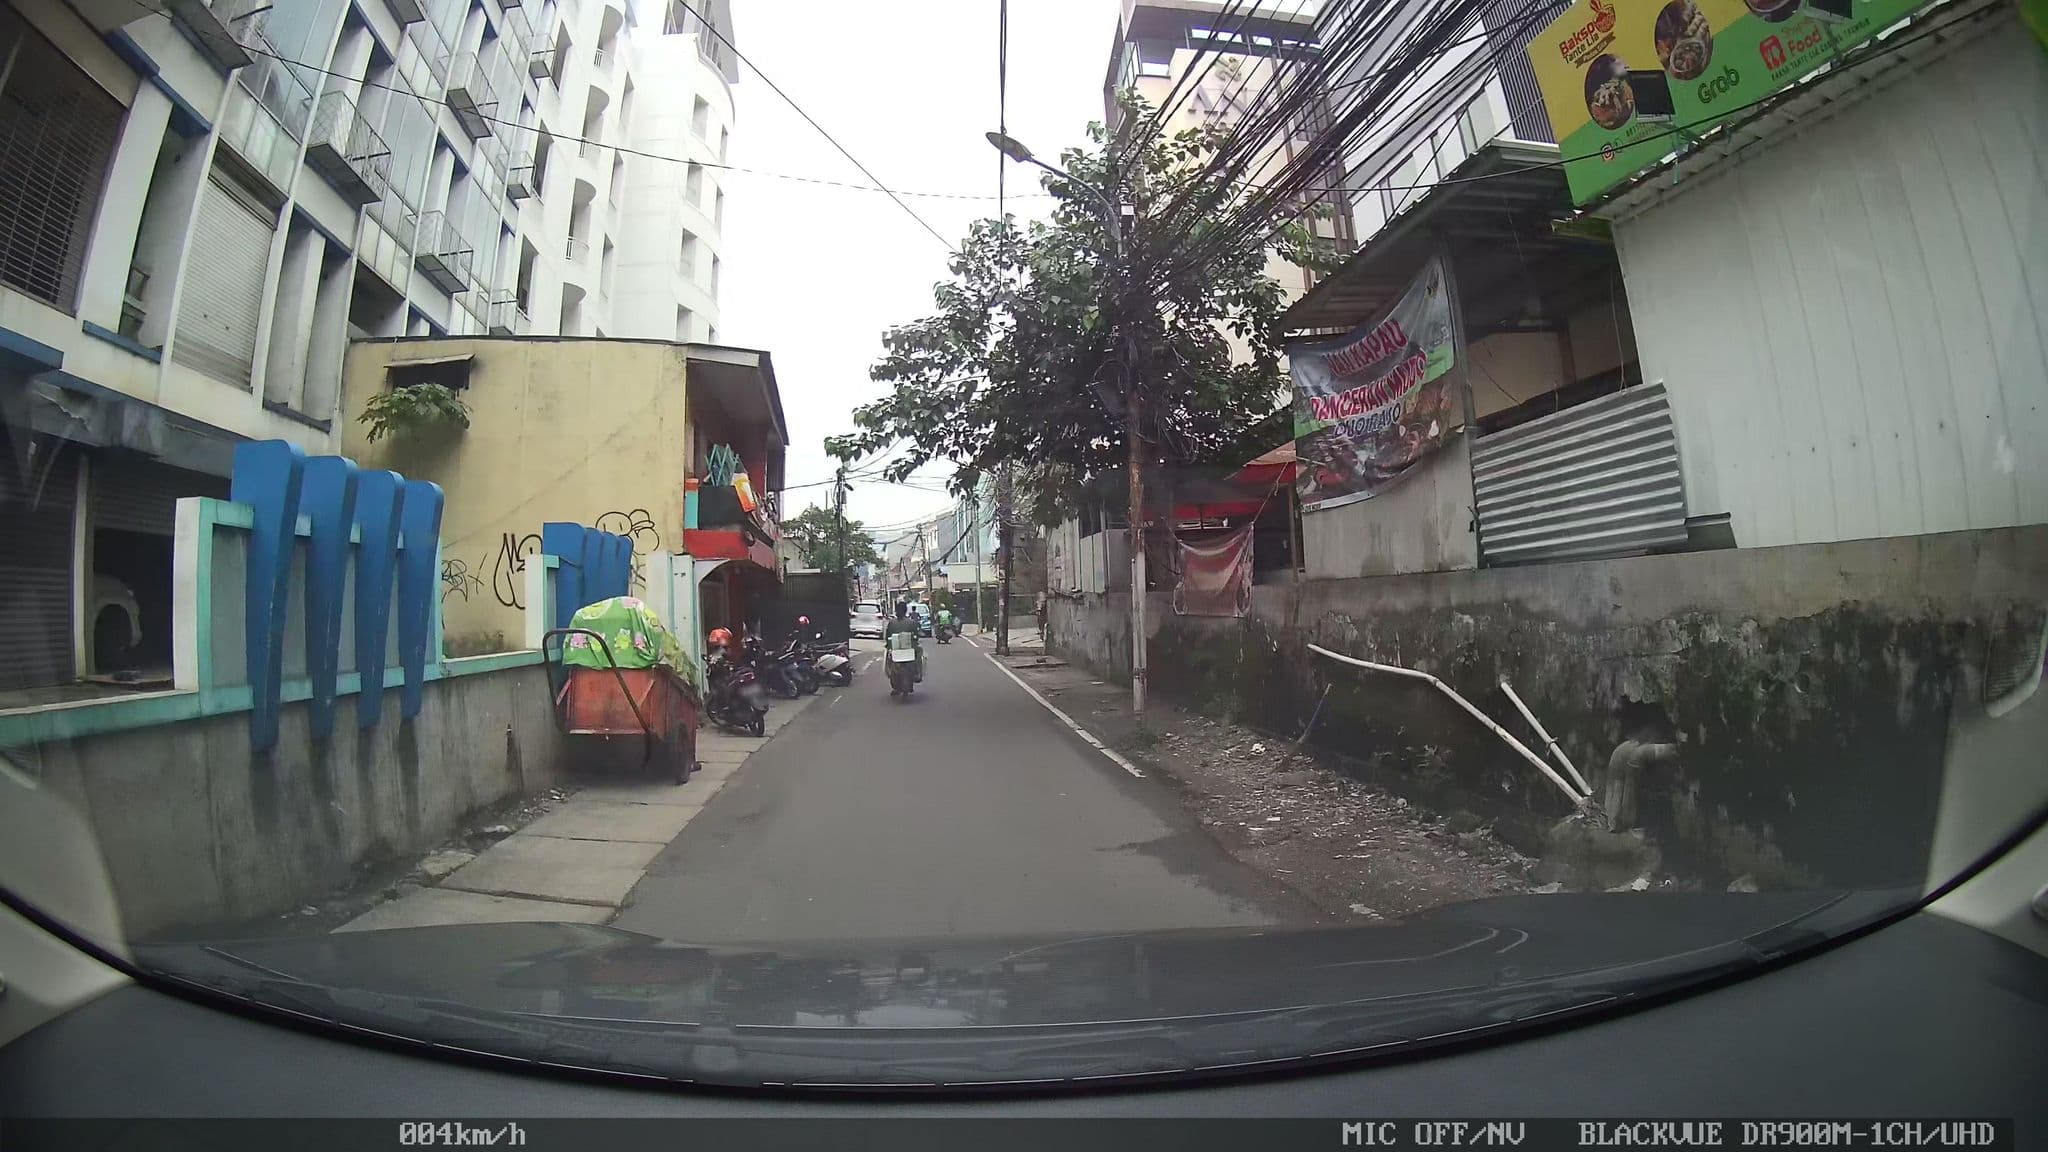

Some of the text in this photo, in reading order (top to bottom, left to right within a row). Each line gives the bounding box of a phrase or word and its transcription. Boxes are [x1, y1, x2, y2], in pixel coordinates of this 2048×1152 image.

[1559, 22, 1596, 55] Bakso
[1563, 44, 1587, 64] Tante
[1697, 65, 1740, 104] Grab
